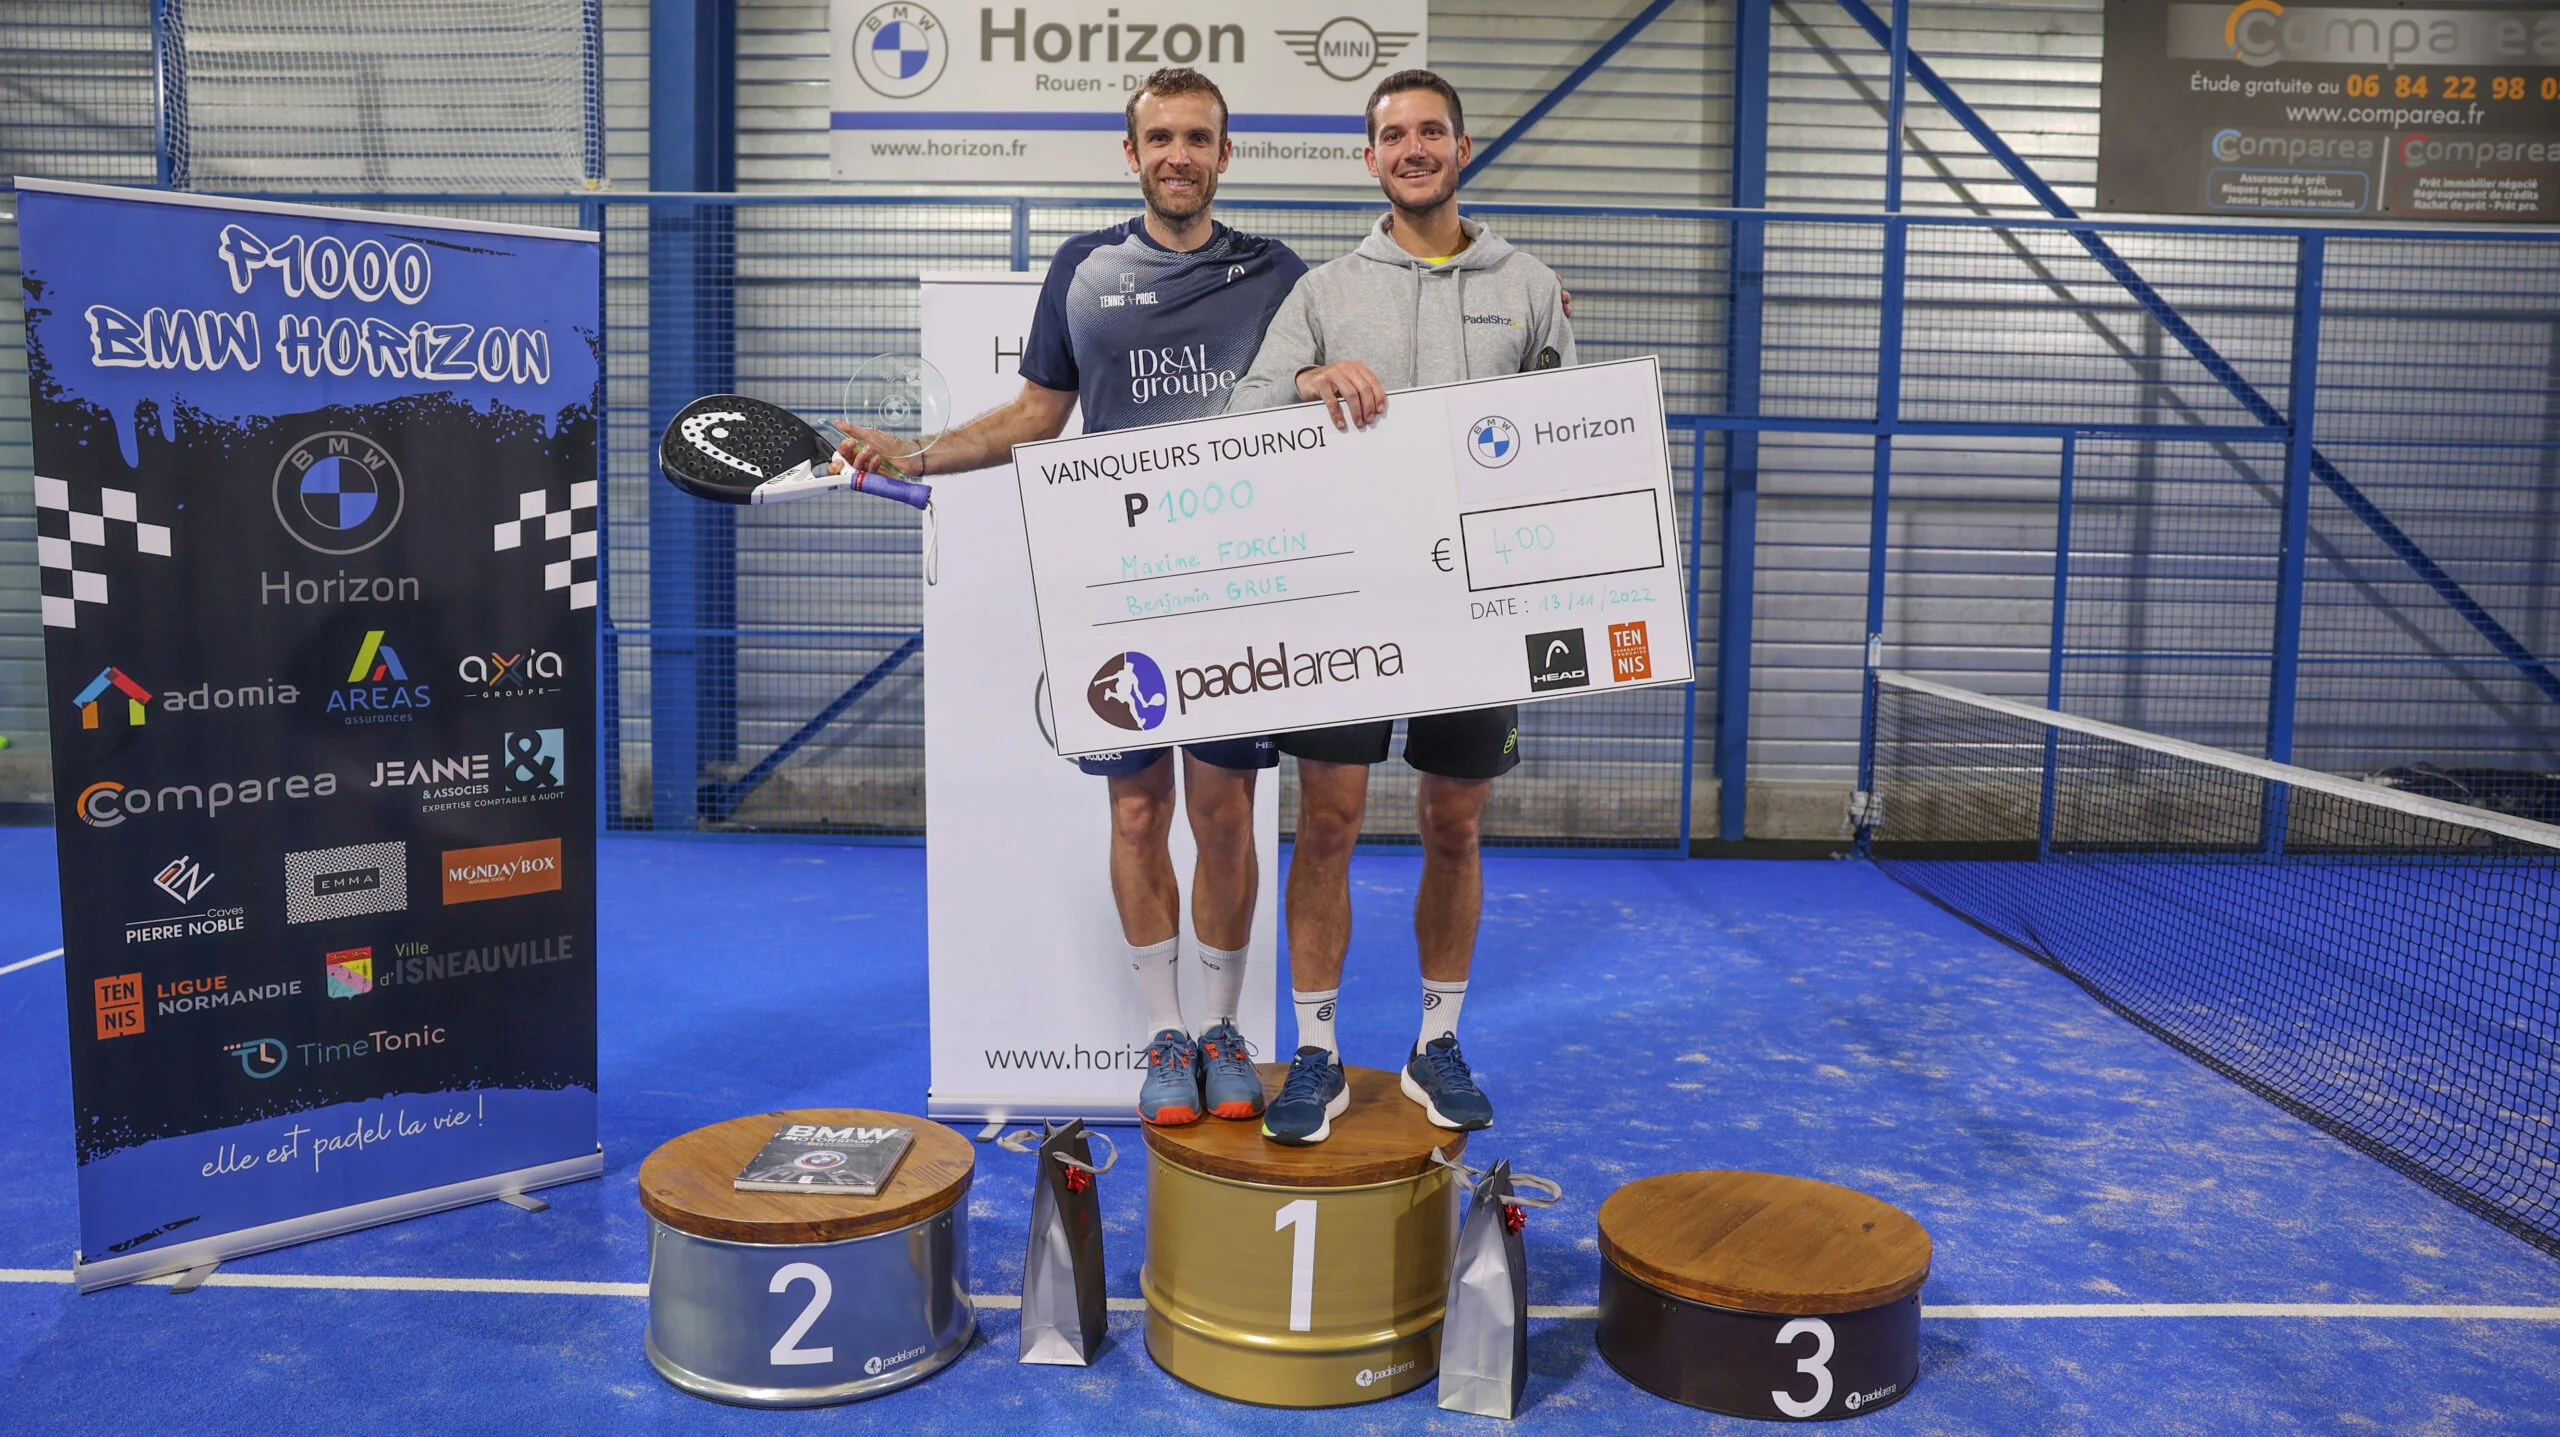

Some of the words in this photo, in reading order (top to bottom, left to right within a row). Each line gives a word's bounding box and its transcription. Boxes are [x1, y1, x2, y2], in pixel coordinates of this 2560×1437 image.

[980, 8, 1245, 63] Horizon
[1324, 41, 1371, 57] MINI
[1035, 74, 1101, 91] Rouen
[2191, 70, 2240, 92] Étude
[2245, 78, 2313, 97] gratuite
[2318, 83, 2340, 94] au
[2346, 74, 2380, 97] 06
[2395, 75, 2428, 98] 84
[2442, 76, 2477, 99] 22
[2492, 76, 2526, 100] 98
[2540, 77, 2560, 100] 0
[2286, 102, 2485, 129] www.comparea.fr
[871, 139, 1027, 157] www.horizon.fr
[2212, 128, 2374, 164] Comparea
[219, 225, 430, 304] P1000
[1100, 295, 1125, 308] TENNIS
[1136, 292, 1158, 305] PADEL
[85, 305, 261, 371] BMW
[1132, 369, 1236, 404] groupe
[1535, 415, 1636, 445] Horizon
[1041, 444, 1200, 485] VAINQUEURS
[1208, 426, 1327, 462] TOURNOI
[1124, 492, 1149, 527] P
[1158, 480, 1255, 523] 1000
[1431, 538, 1454, 572] €
[1493, 524, 1555, 564] 400
[1121, 553, 1200, 580] Maxime
[261, 570, 420, 605] Horizon
[1126, 587, 1210, 616] Benjamin
[1226, 576, 1288, 600] GRUE
[1613, 629, 1642, 647] TEN
[1534, 669, 1586, 684] HEAD
[1618, 656, 1645, 675] NIS
[163, 678, 300, 711] adomia
[326, 685, 431, 712] AREAS
[482, 688, 545, 699] GROUPE
[344, 713, 413, 725] assurances
[369, 754, 489, 787] JEANNE
[76, 772, 337, 828] Comparea
[422, 789, 431, 799] &
[433, 784, 489, 799] ASSOCIES
[422, 800, 472, 813] EXPERTISE
[474, 795, 528, 808] COMPTABLE
[538, 791, 565, 802] AUDIT
[322, 874, 374, 889] EMMA
[207, 906, 244, 918] Caves
[126, 924, 183, 944] PIERRE
[188, 917, 245, 936] NOBLE
[395, 941, 429, 957] Ville
[101, 982, 135, 1002] TEN
[157, 975, 228, 998] LIGUE
[158, 980, 302, 1016] NORMANDIE
[104, 1010, 137, 1030] NIS
[296, 1025, 446, 1066] TimeTonic
[202, 1143, 259, 1177] elle
[266, 1125, 310, 1164] est
[314, 1113, 390, 1173] padel
[398, 1109, 427, 1137] la
[433, 1104, 472, 1131] vie
[781, 1136, 882, 1145] MOTORSPORT
[786, 1125, 899, 1140] BMW
[1274, 1199, 1317, 1332] 1
[768, 1262, 834, 1366] 2
[1771, 1317, 1835, 1418] 3
